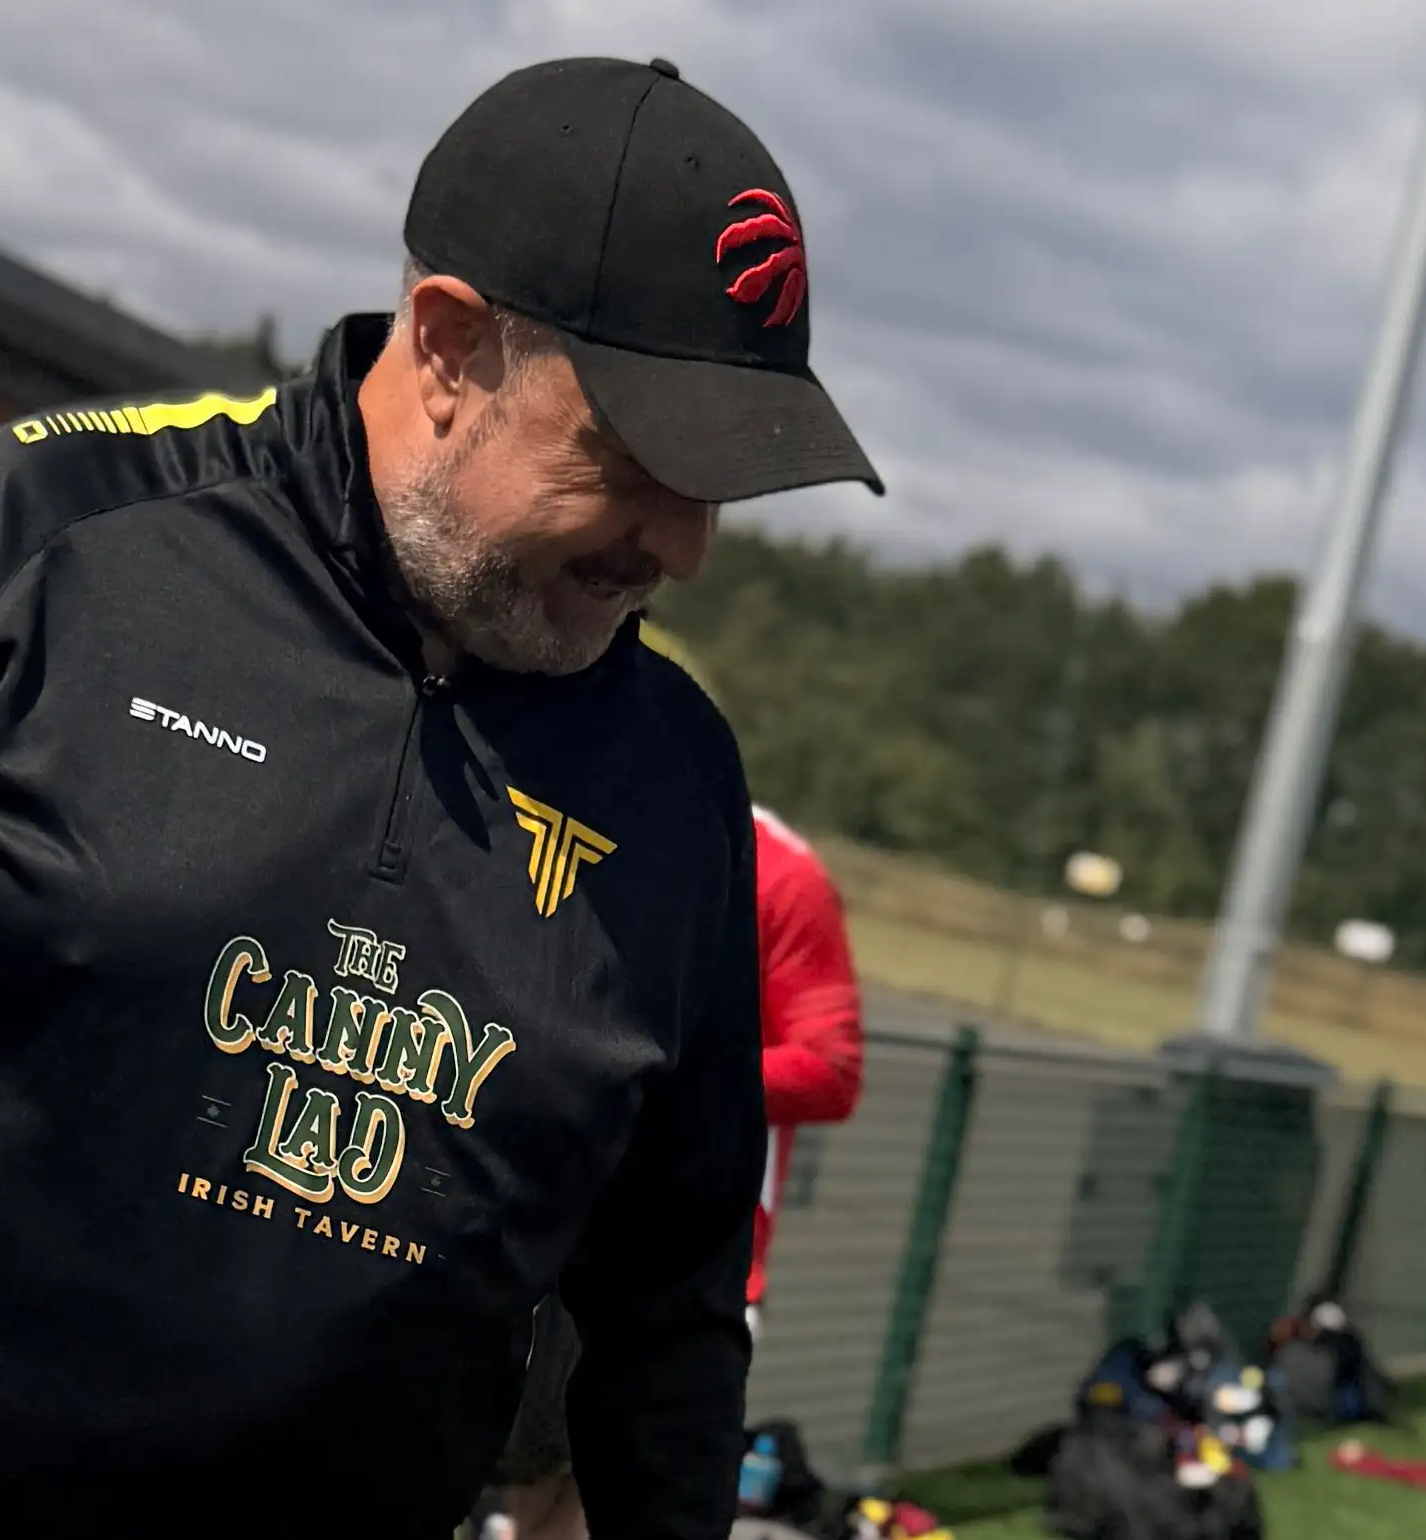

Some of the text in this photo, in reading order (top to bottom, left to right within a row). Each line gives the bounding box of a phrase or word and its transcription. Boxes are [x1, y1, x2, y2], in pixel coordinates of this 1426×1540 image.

[129, 697, 267, 763] STANNO
[327, 918, 406, 994] THE
[204, 936, 517, 1130] CANNY
[243, 1062, 406, 1204] LAD
[177, 1173, 427, 1265] IRISH TAVERN
